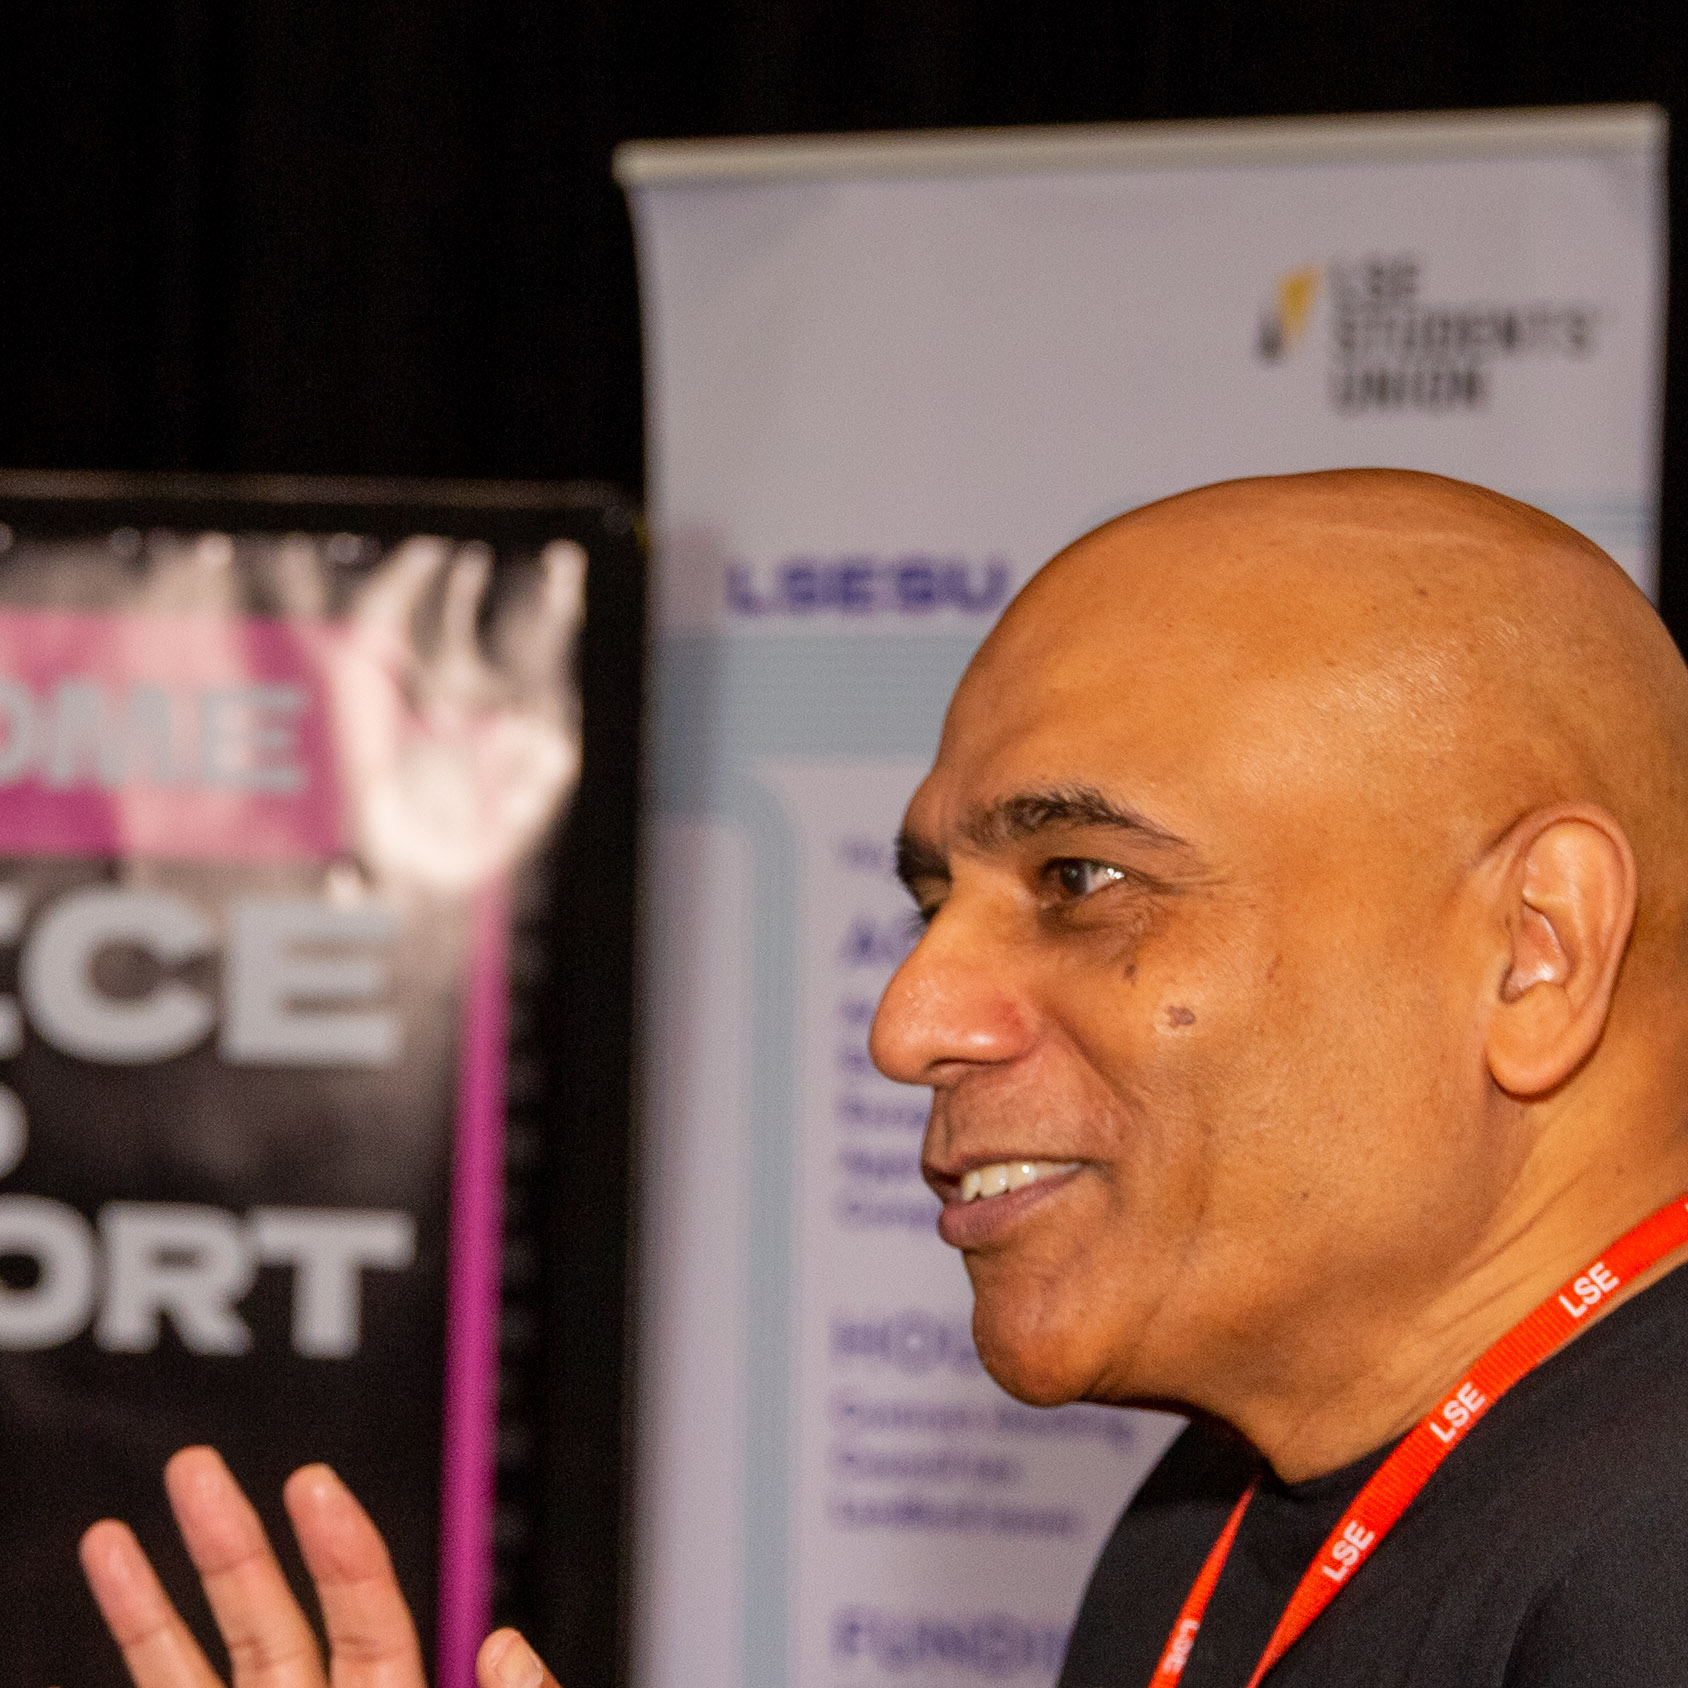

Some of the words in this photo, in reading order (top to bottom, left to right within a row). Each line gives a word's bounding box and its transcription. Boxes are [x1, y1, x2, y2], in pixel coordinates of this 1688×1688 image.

[1557, 1261, 1620, 1318] LSE
[1429, 1381, 1487, 1443] LSE
[1321, 1519, 1375, 1582] LSE
